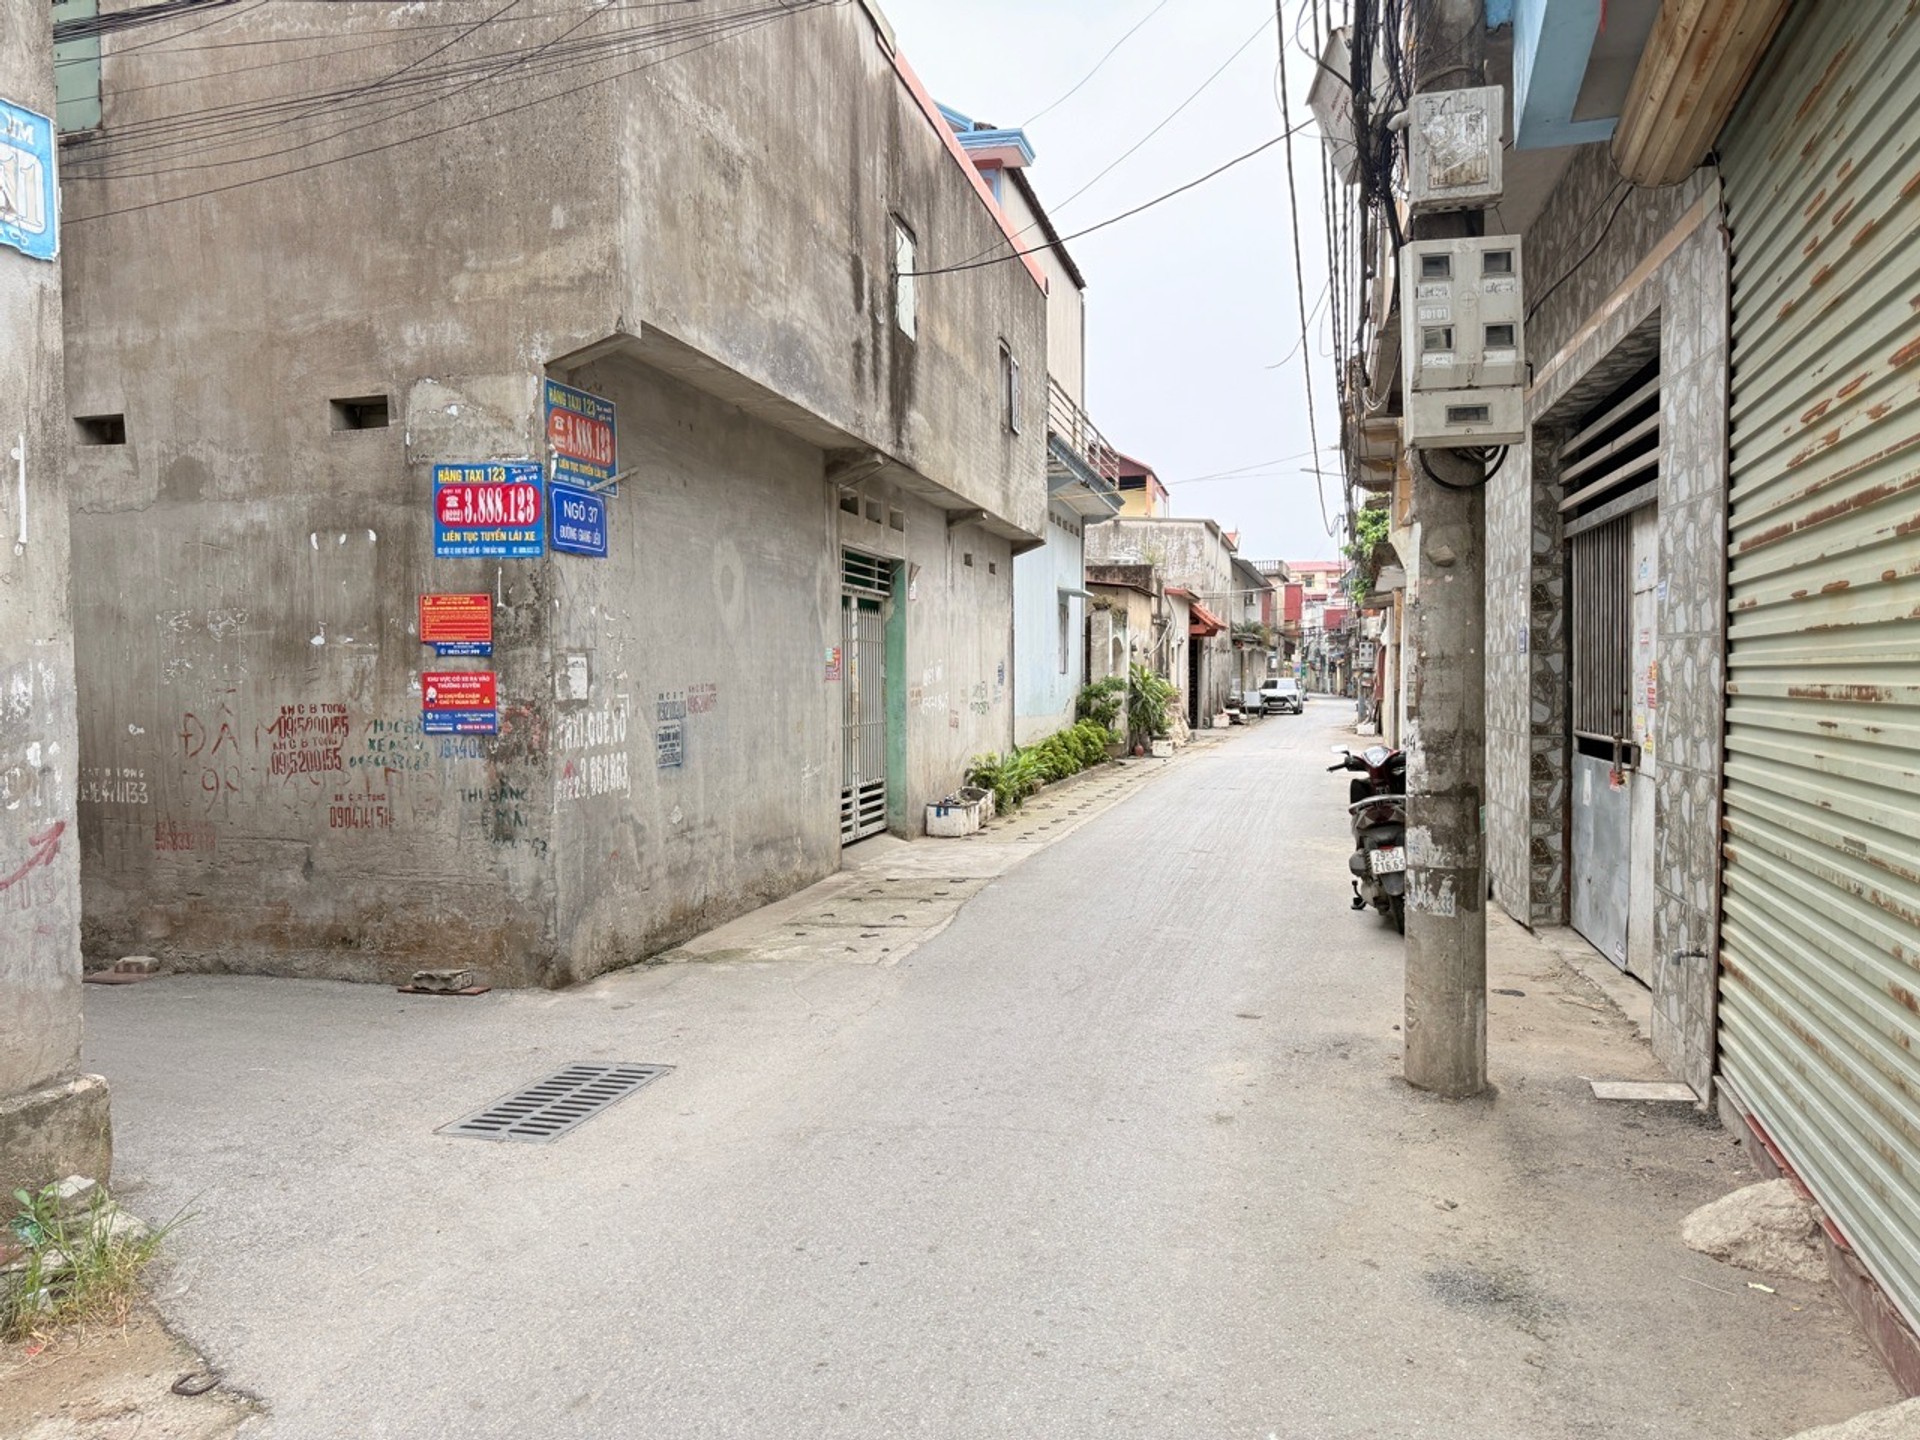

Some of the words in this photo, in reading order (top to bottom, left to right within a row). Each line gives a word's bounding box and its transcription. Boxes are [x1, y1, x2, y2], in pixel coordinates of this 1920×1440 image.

[464, 469, 484, 483] TAXI
[487, 466, 506, 483] 123
[464, 487, 535, 523] 3.888.123
[563, 499, 586, 521] NGÕ
[587, 506, 599, 524] 37
[442, 529, 461, 542] LIÊN
[523, 531, 536, 541] XE
